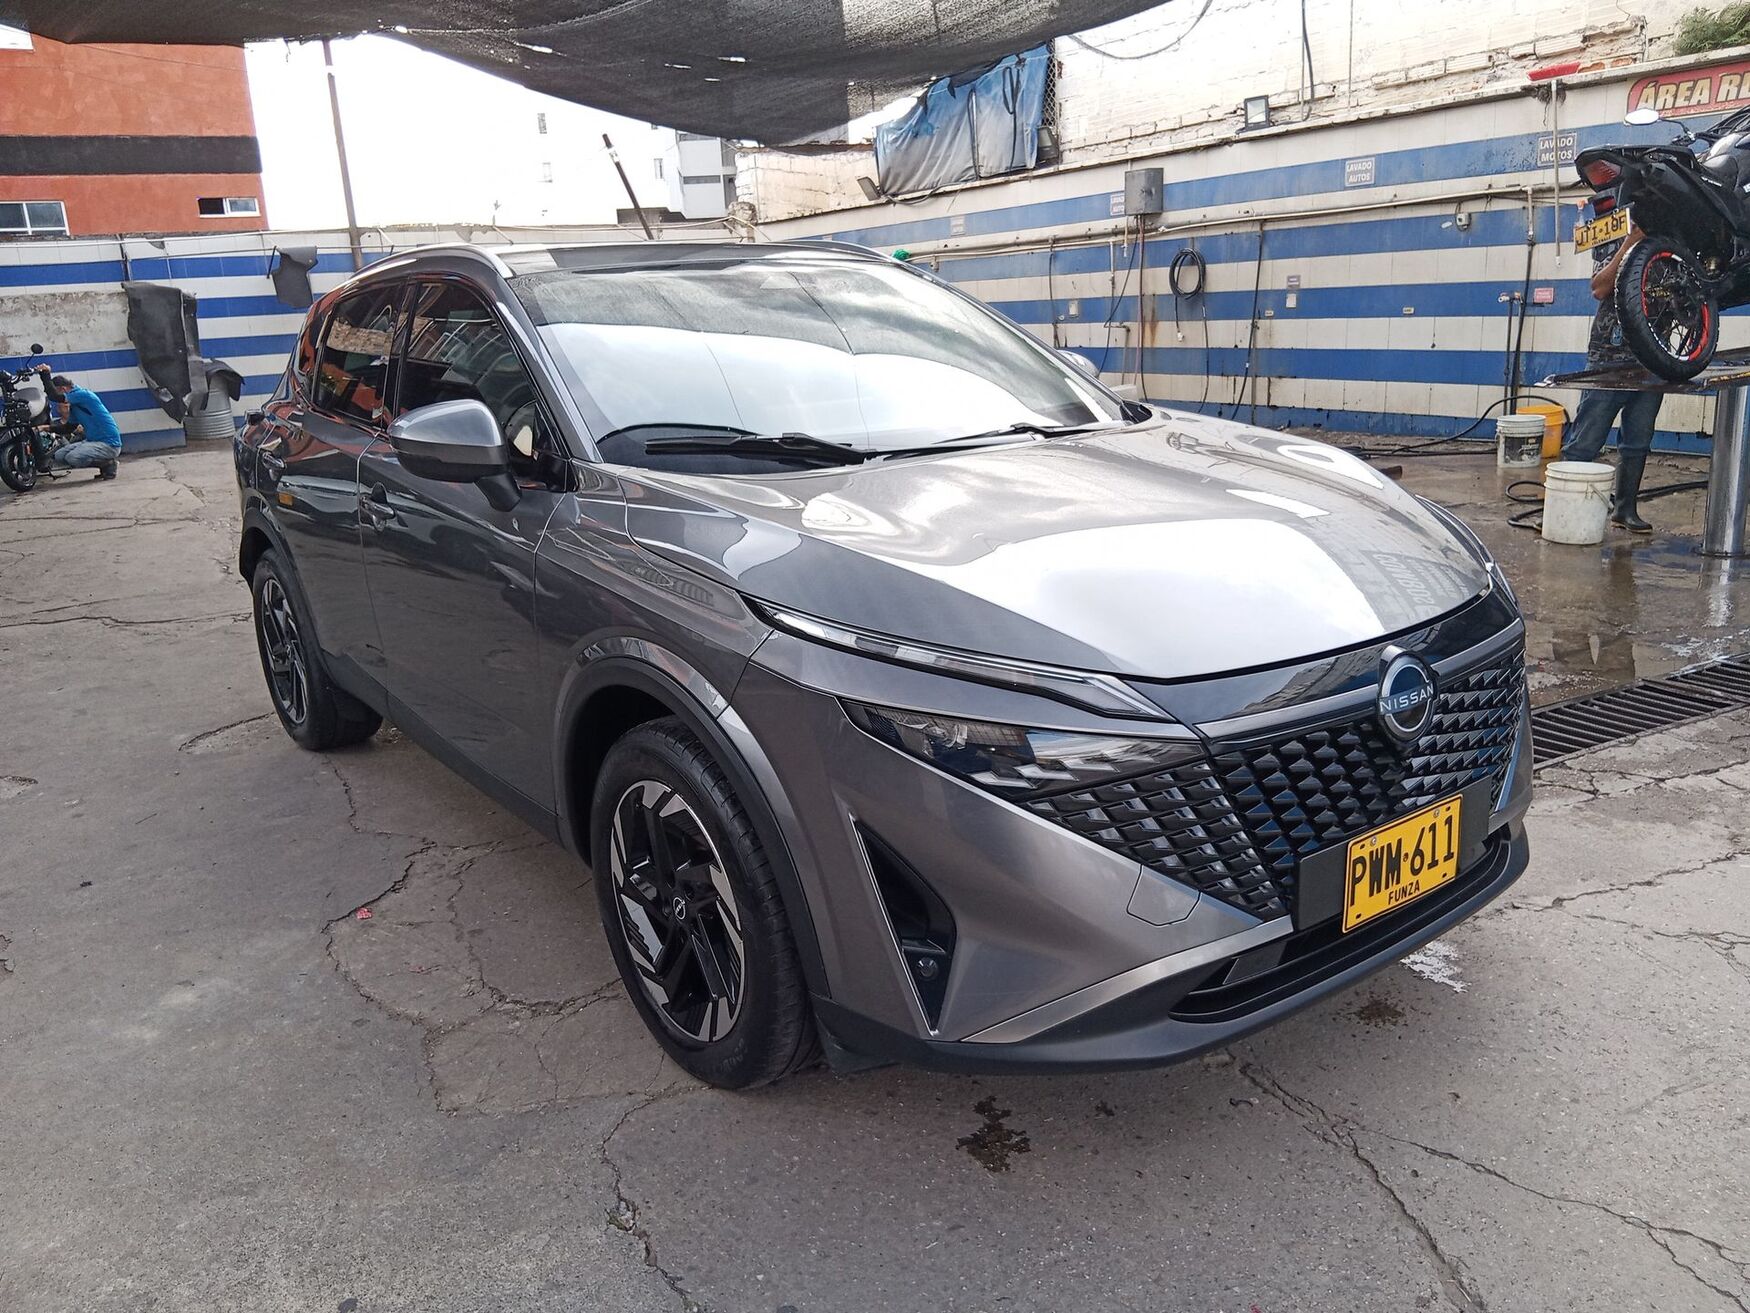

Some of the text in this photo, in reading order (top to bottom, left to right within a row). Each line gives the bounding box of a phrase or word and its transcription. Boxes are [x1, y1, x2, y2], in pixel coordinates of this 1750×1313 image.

[1635, 77, 1711, 111] ÁREA
[1346, 161, 1372, 172] LAVADO
[1348, 173, 1371, 183] AUTOS
[1380, 683, 1434, 712] NISSAN
[1388, 879, 1421, 905] FUNZA
